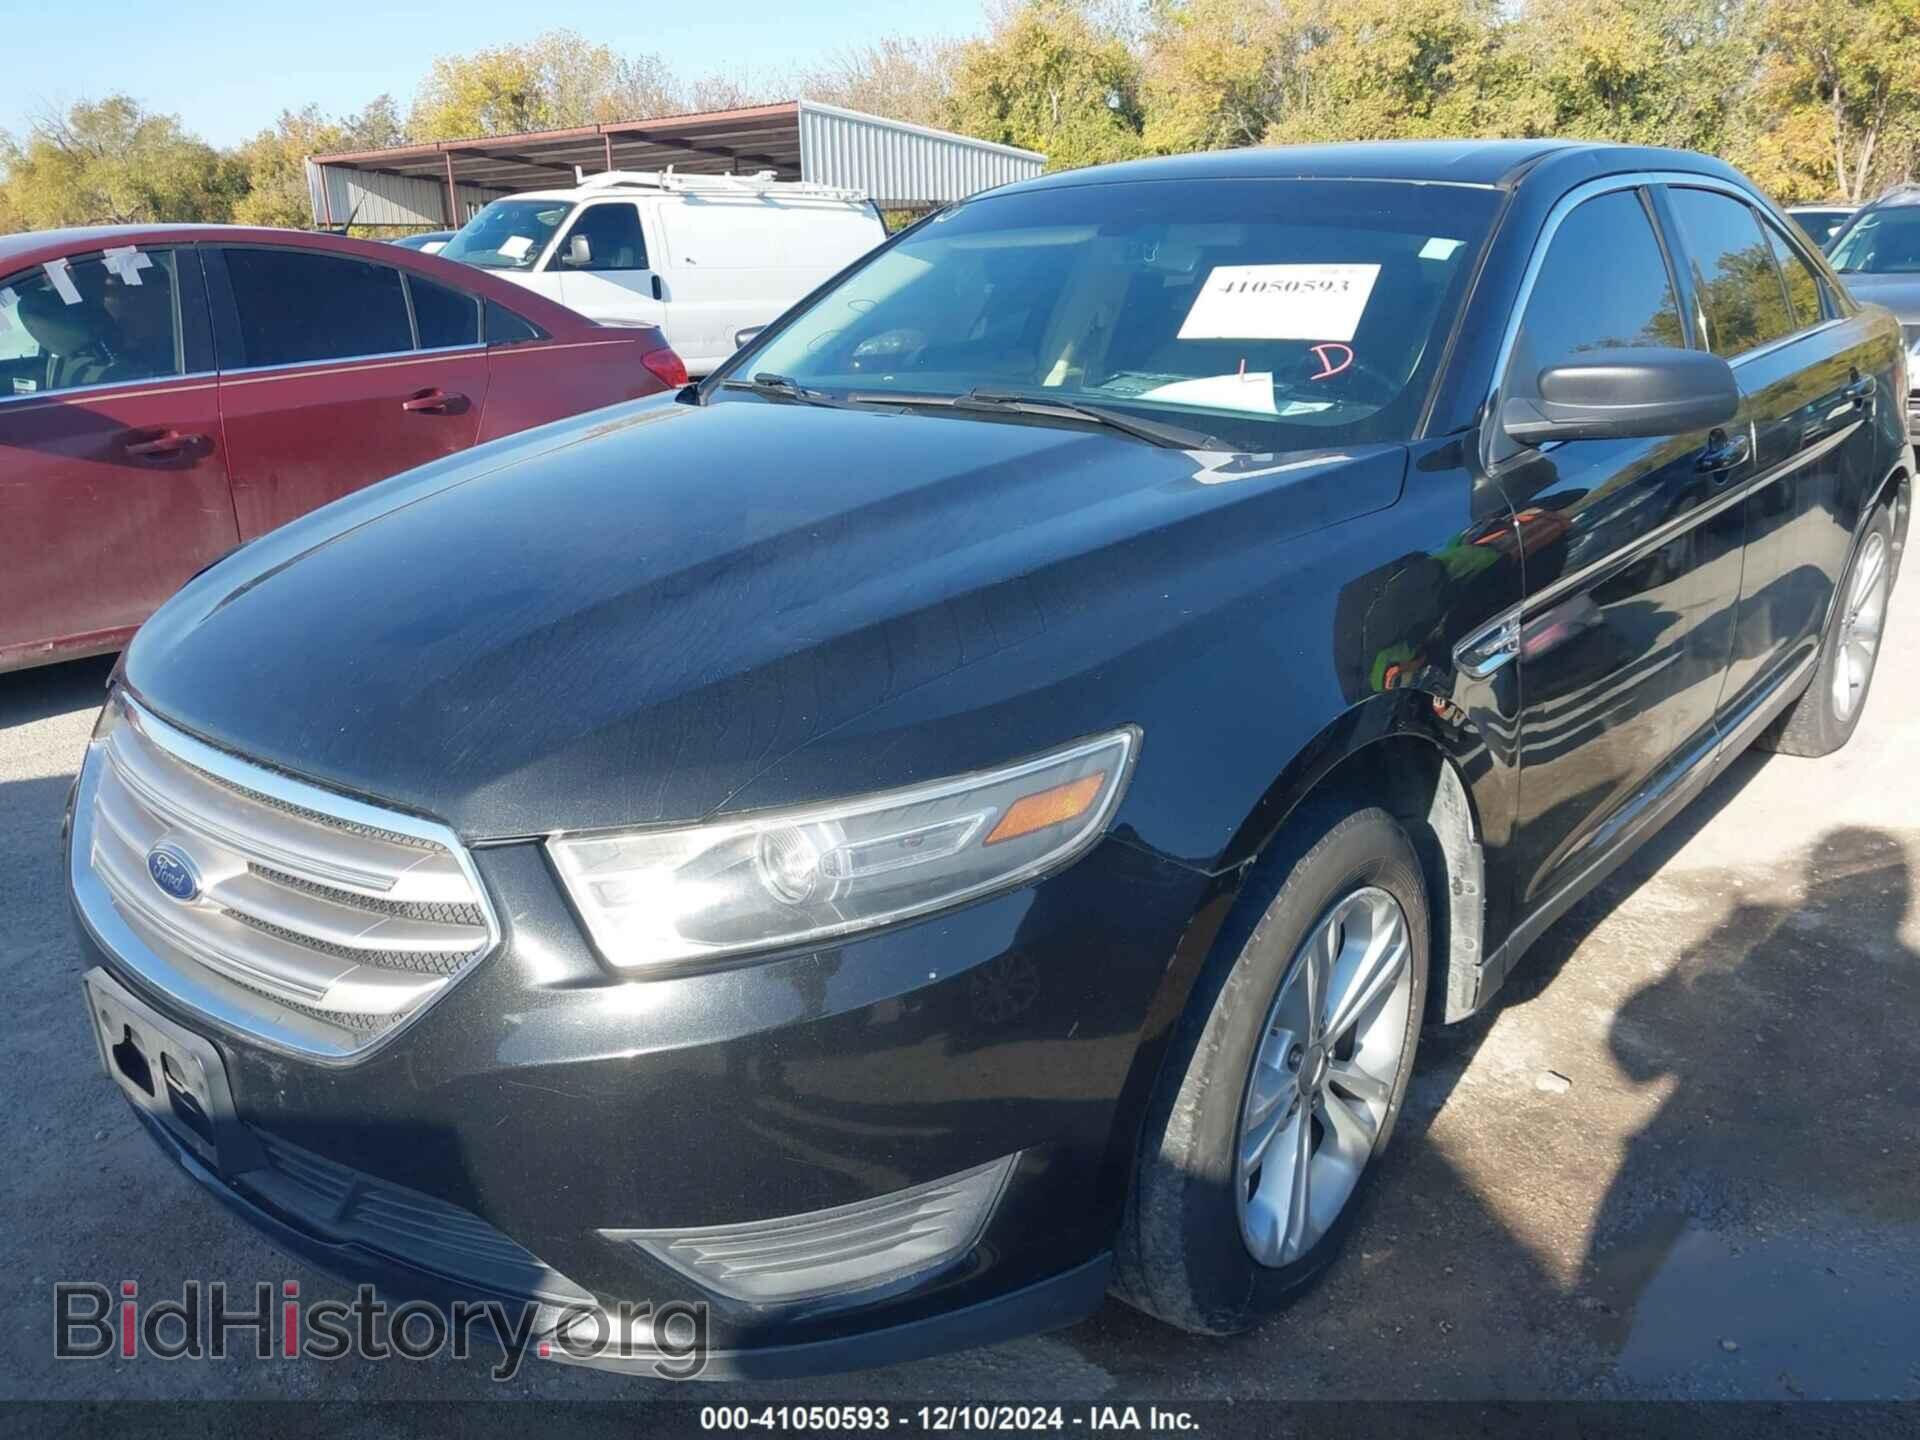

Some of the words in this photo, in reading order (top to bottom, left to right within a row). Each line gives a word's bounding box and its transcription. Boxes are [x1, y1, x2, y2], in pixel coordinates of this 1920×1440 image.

[1219, 280, 1350, 293] 41050593
[1309, 343, 1354, 381] D
[153, 854, 185, 891] Ford
